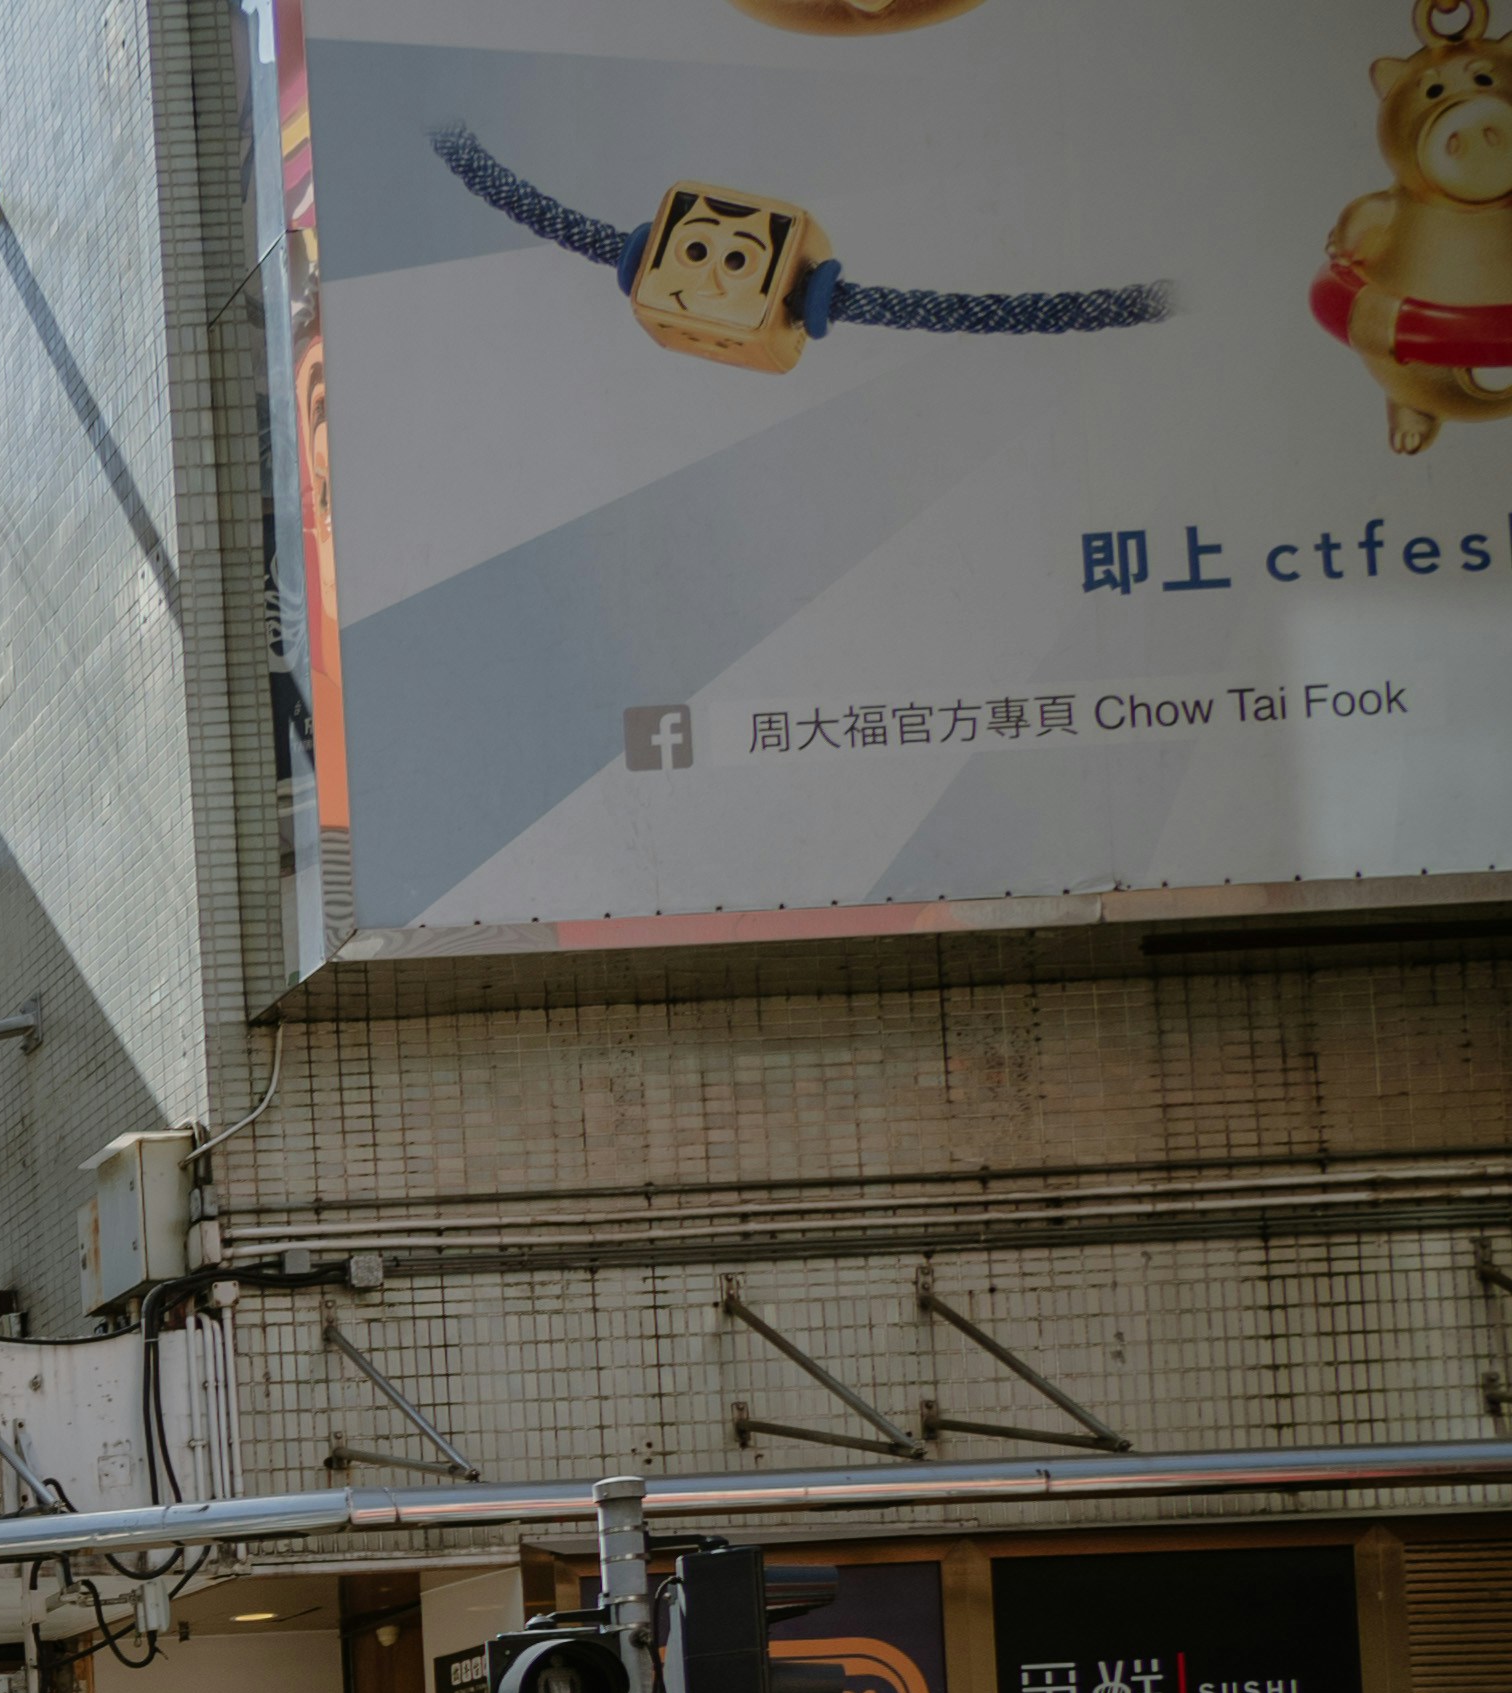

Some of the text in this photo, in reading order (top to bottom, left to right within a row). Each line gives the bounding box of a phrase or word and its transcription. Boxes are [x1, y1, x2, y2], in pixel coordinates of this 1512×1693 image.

[1081, 514, 1512, 596] 即上 ctfes
[749, 681, 1408, 754] 周大福官方專頁 Chow Tai Fook
